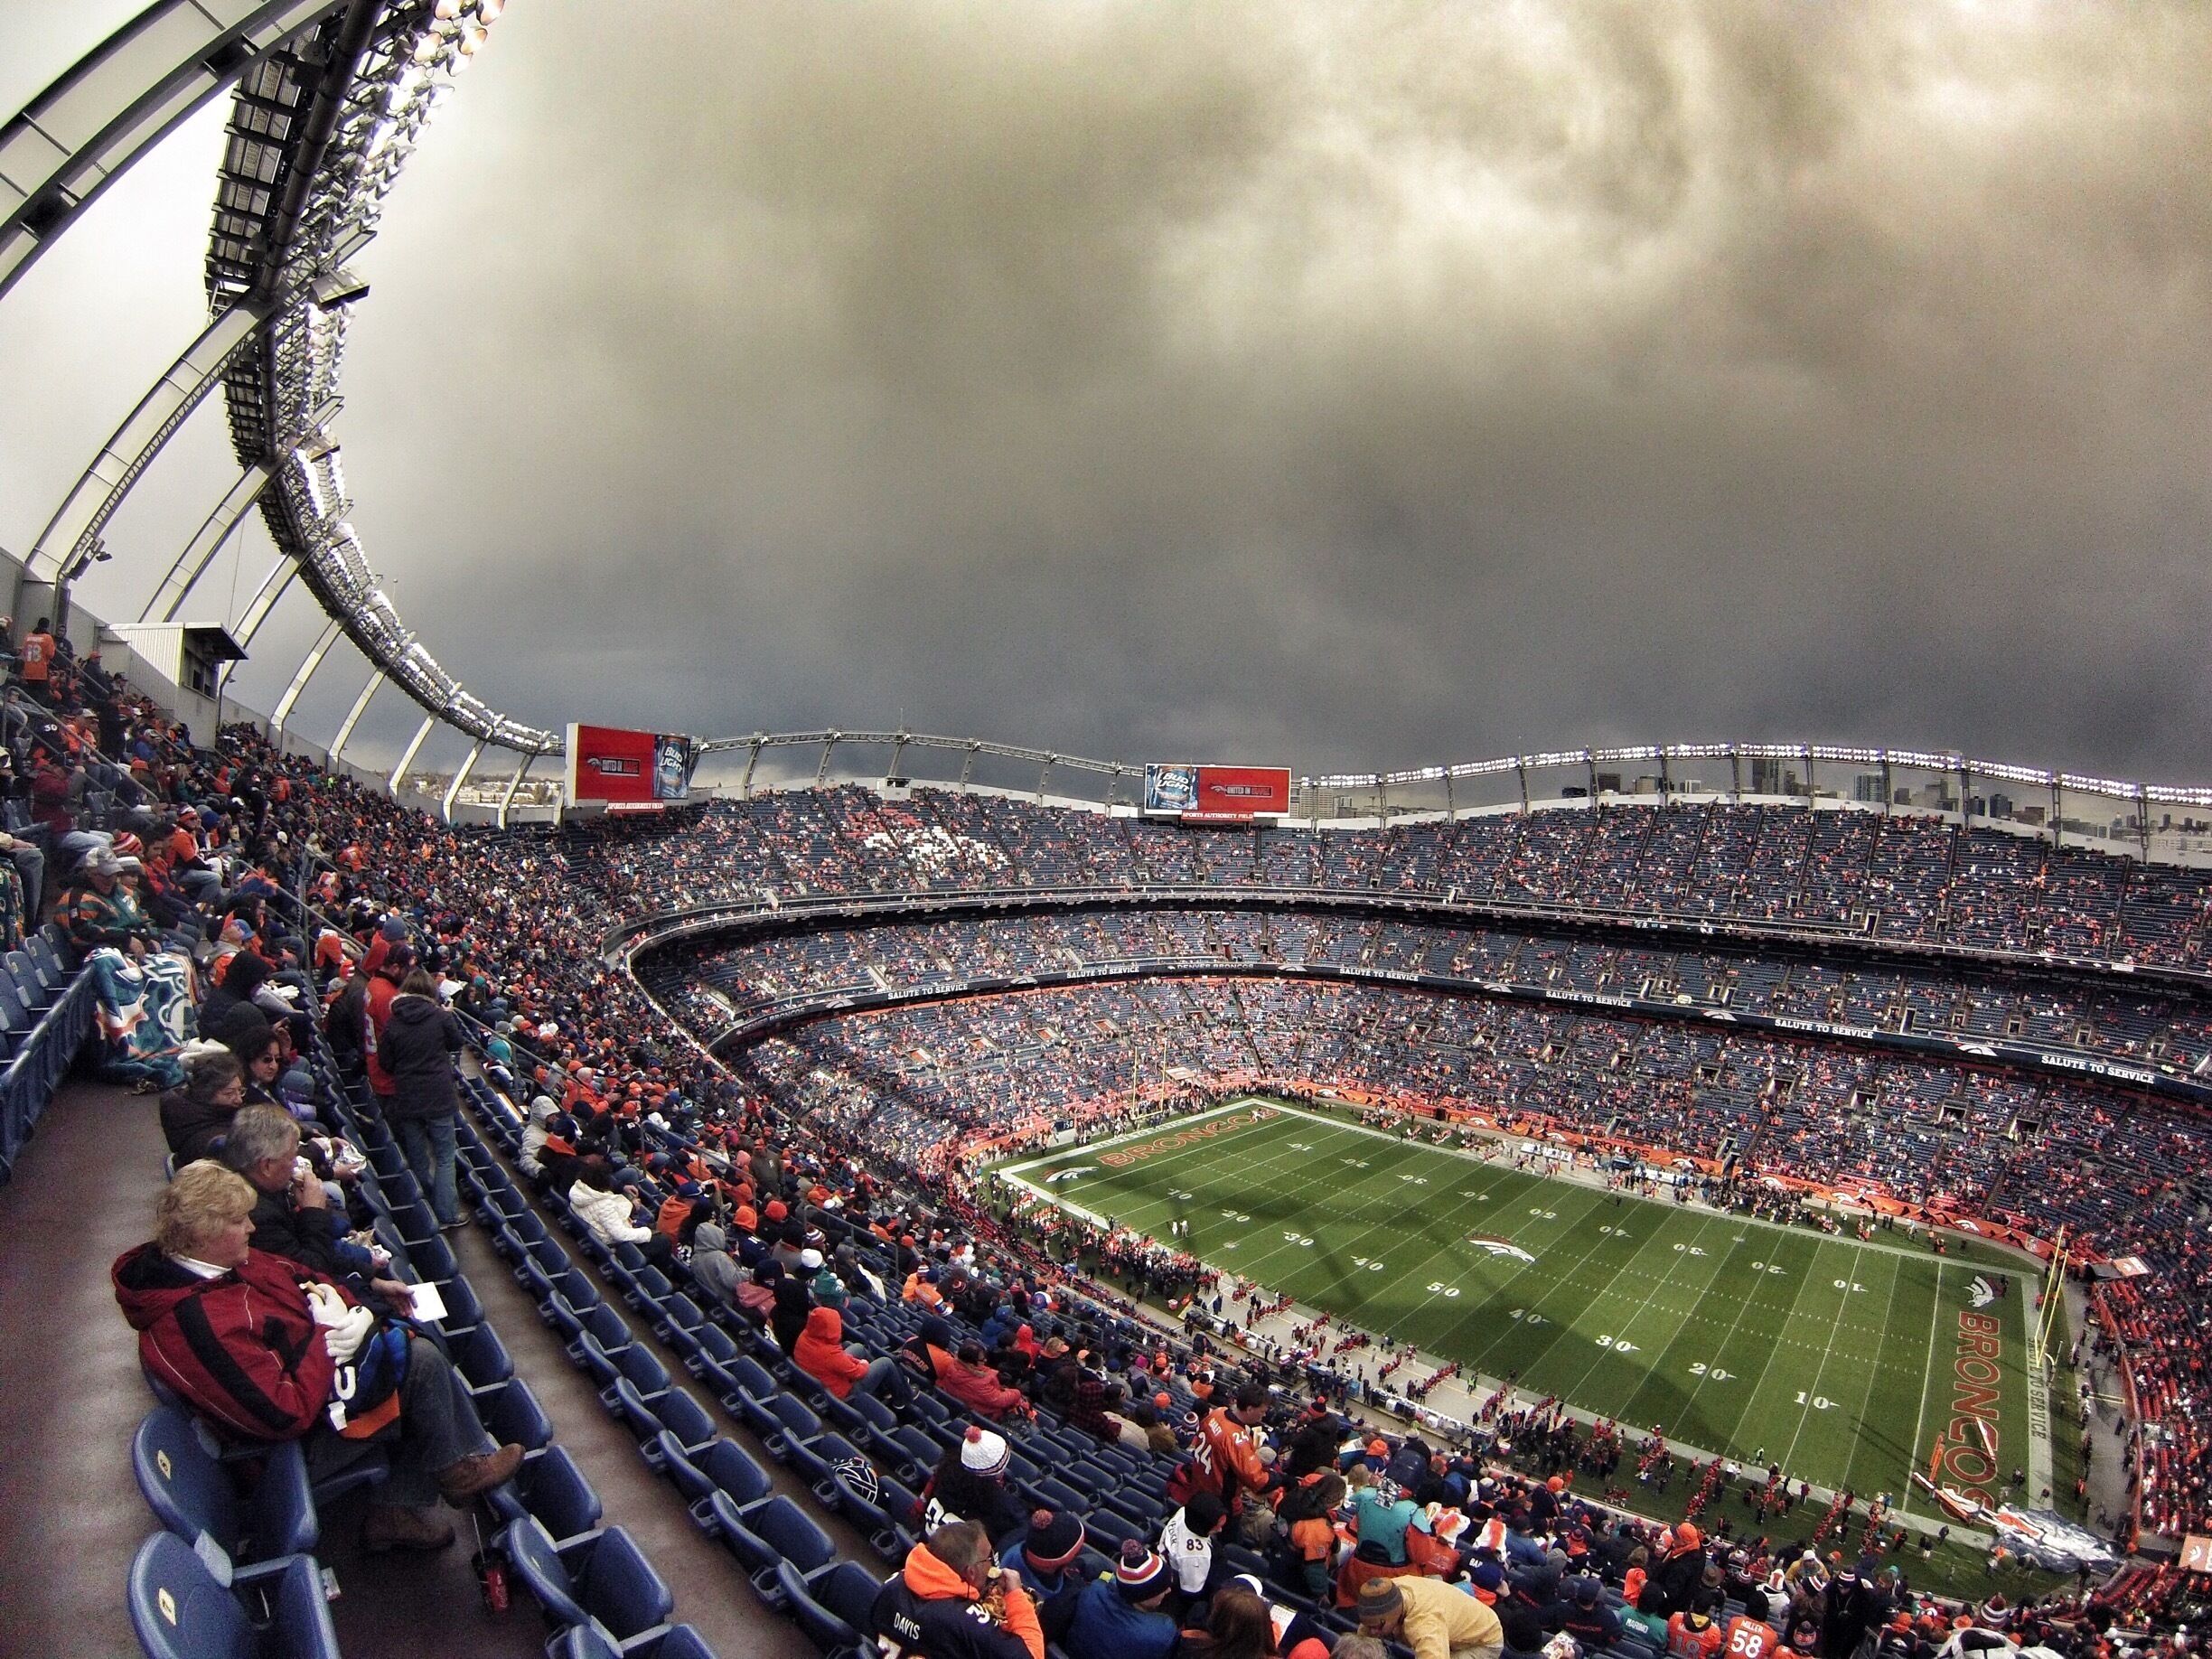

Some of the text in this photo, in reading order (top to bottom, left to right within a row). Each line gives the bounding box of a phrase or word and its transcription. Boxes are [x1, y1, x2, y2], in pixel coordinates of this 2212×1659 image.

[664, 746, 683, 763] BUD
[1157, 779, 1189, 792] LIGHT
[1162, 773, 1189, 784] BUD
[1066, 966, 1139, 979] SALUTE TO SERVICE
[1339, 968, 1371, 976] SALUTE
[1386, 972, 1419, 981] SERVICE
[887, 983, 968, 1000] SALUTE TO SERVICE
[1545, 990, 1579, 1001] SALUTE
[1596, 997, 1632, 1008] SERVICE
[1775, 1018, 1874, 1039] SALUTE TO SERVICE
[2041, 1054, 2155, 1084] SALUTE TO SERVICE
[1221, 1209, 1251, 1223] 20
[1529, 1208, 1558, 1220] 50
[1284, 1233, 1315, 1246] 30
[1354, 1256, 1384, 1271] 40
[1426, 1281, 1459, 1298] 50
[1508, 1308, 1542, 1324] 40
[1595, 1335, 1633, 1353] 30
[1688, 1362, 1728, 1382] 20
[2029, 1373, 2044, 1388] TO
[1794, 1391, 1830, 1411] 10
[2029, 1390, 2047, 1439] SERVICE
[1233, 1430, 1250, 1445] 24
[1186, 1538, 1204, 1551] 83
[893, 1612, 921, 1640] DAVIS
[1626, 1617, 1649, 1634] MARINO
[1740, 1619, 1764, 1634] MILLER
[1675, 1635, 1700, 1659] 18
[1730, 1628, 1763, 1659] 58
